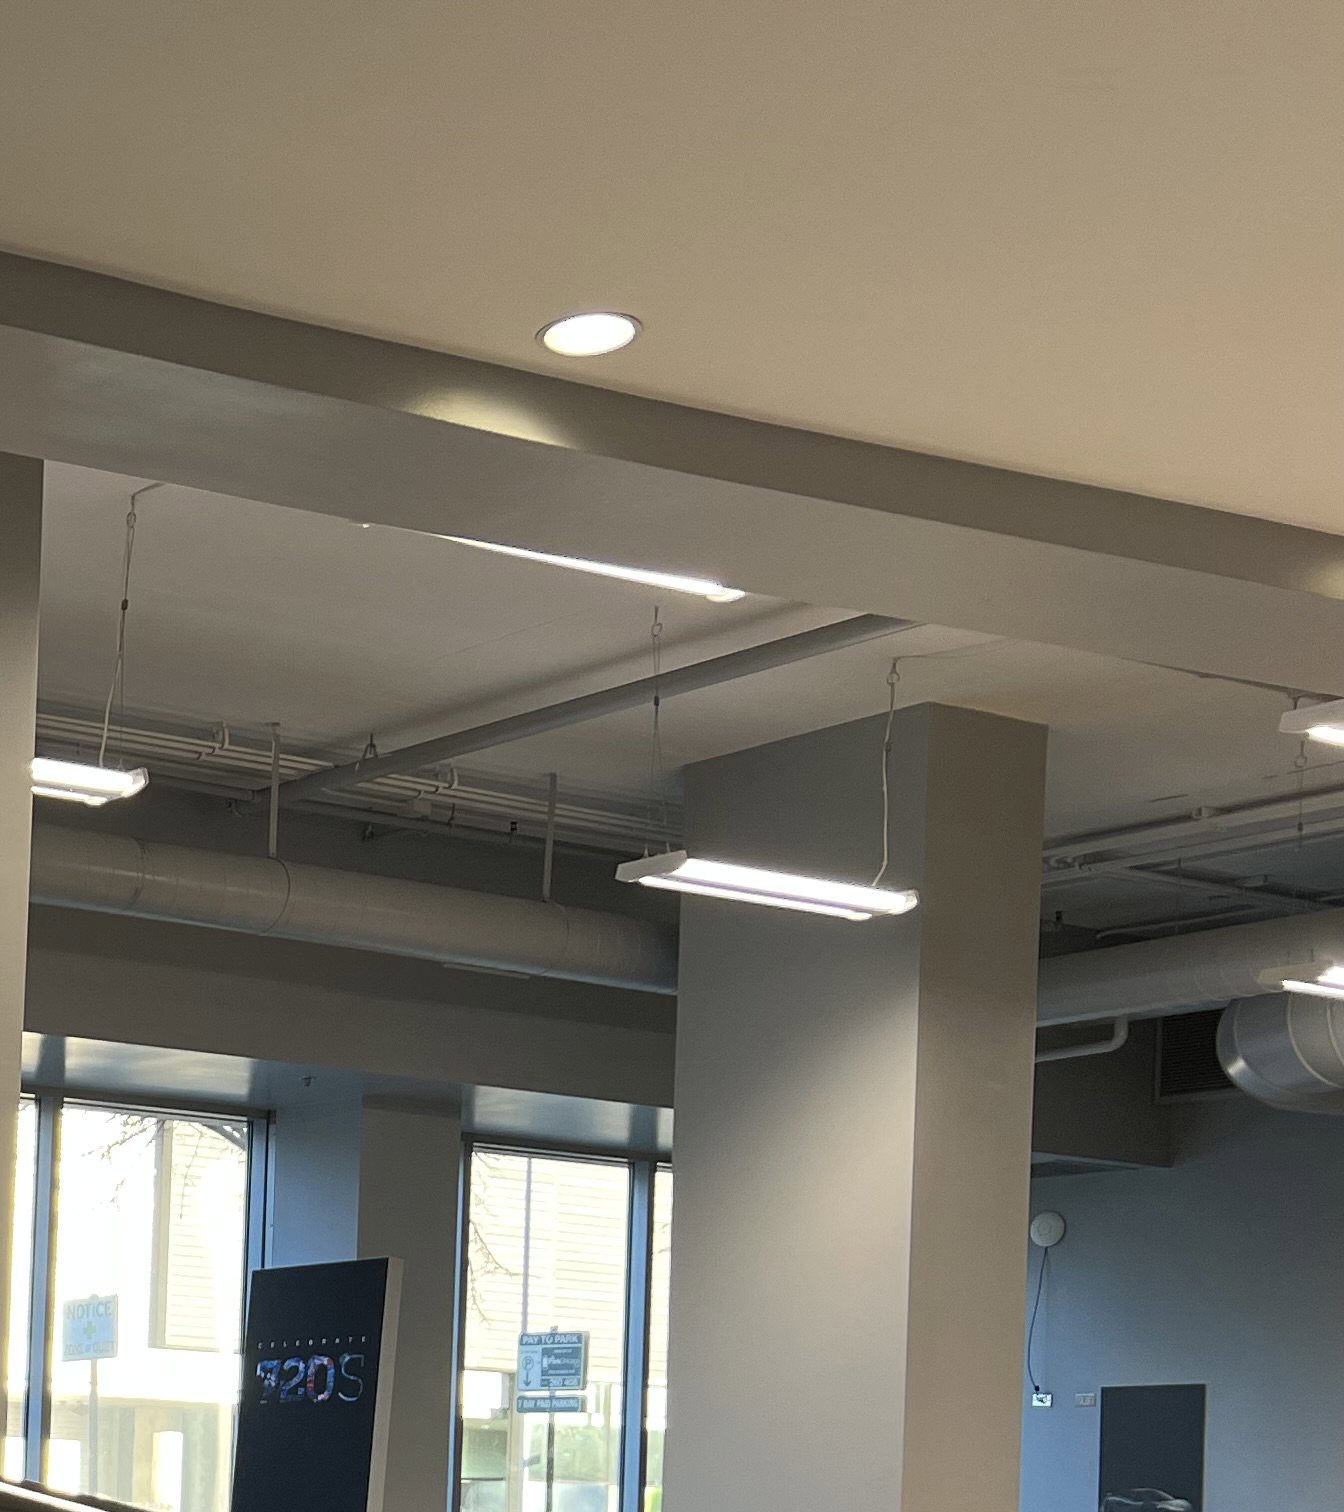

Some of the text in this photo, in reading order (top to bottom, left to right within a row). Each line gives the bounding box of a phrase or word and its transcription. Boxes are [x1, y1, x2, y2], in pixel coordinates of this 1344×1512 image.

[66, 1301, 112, 1320] NOTICE
[523, 1335, 578, 1345] PAY TO PARK
[255, 1353, 366, 1404] 720S
